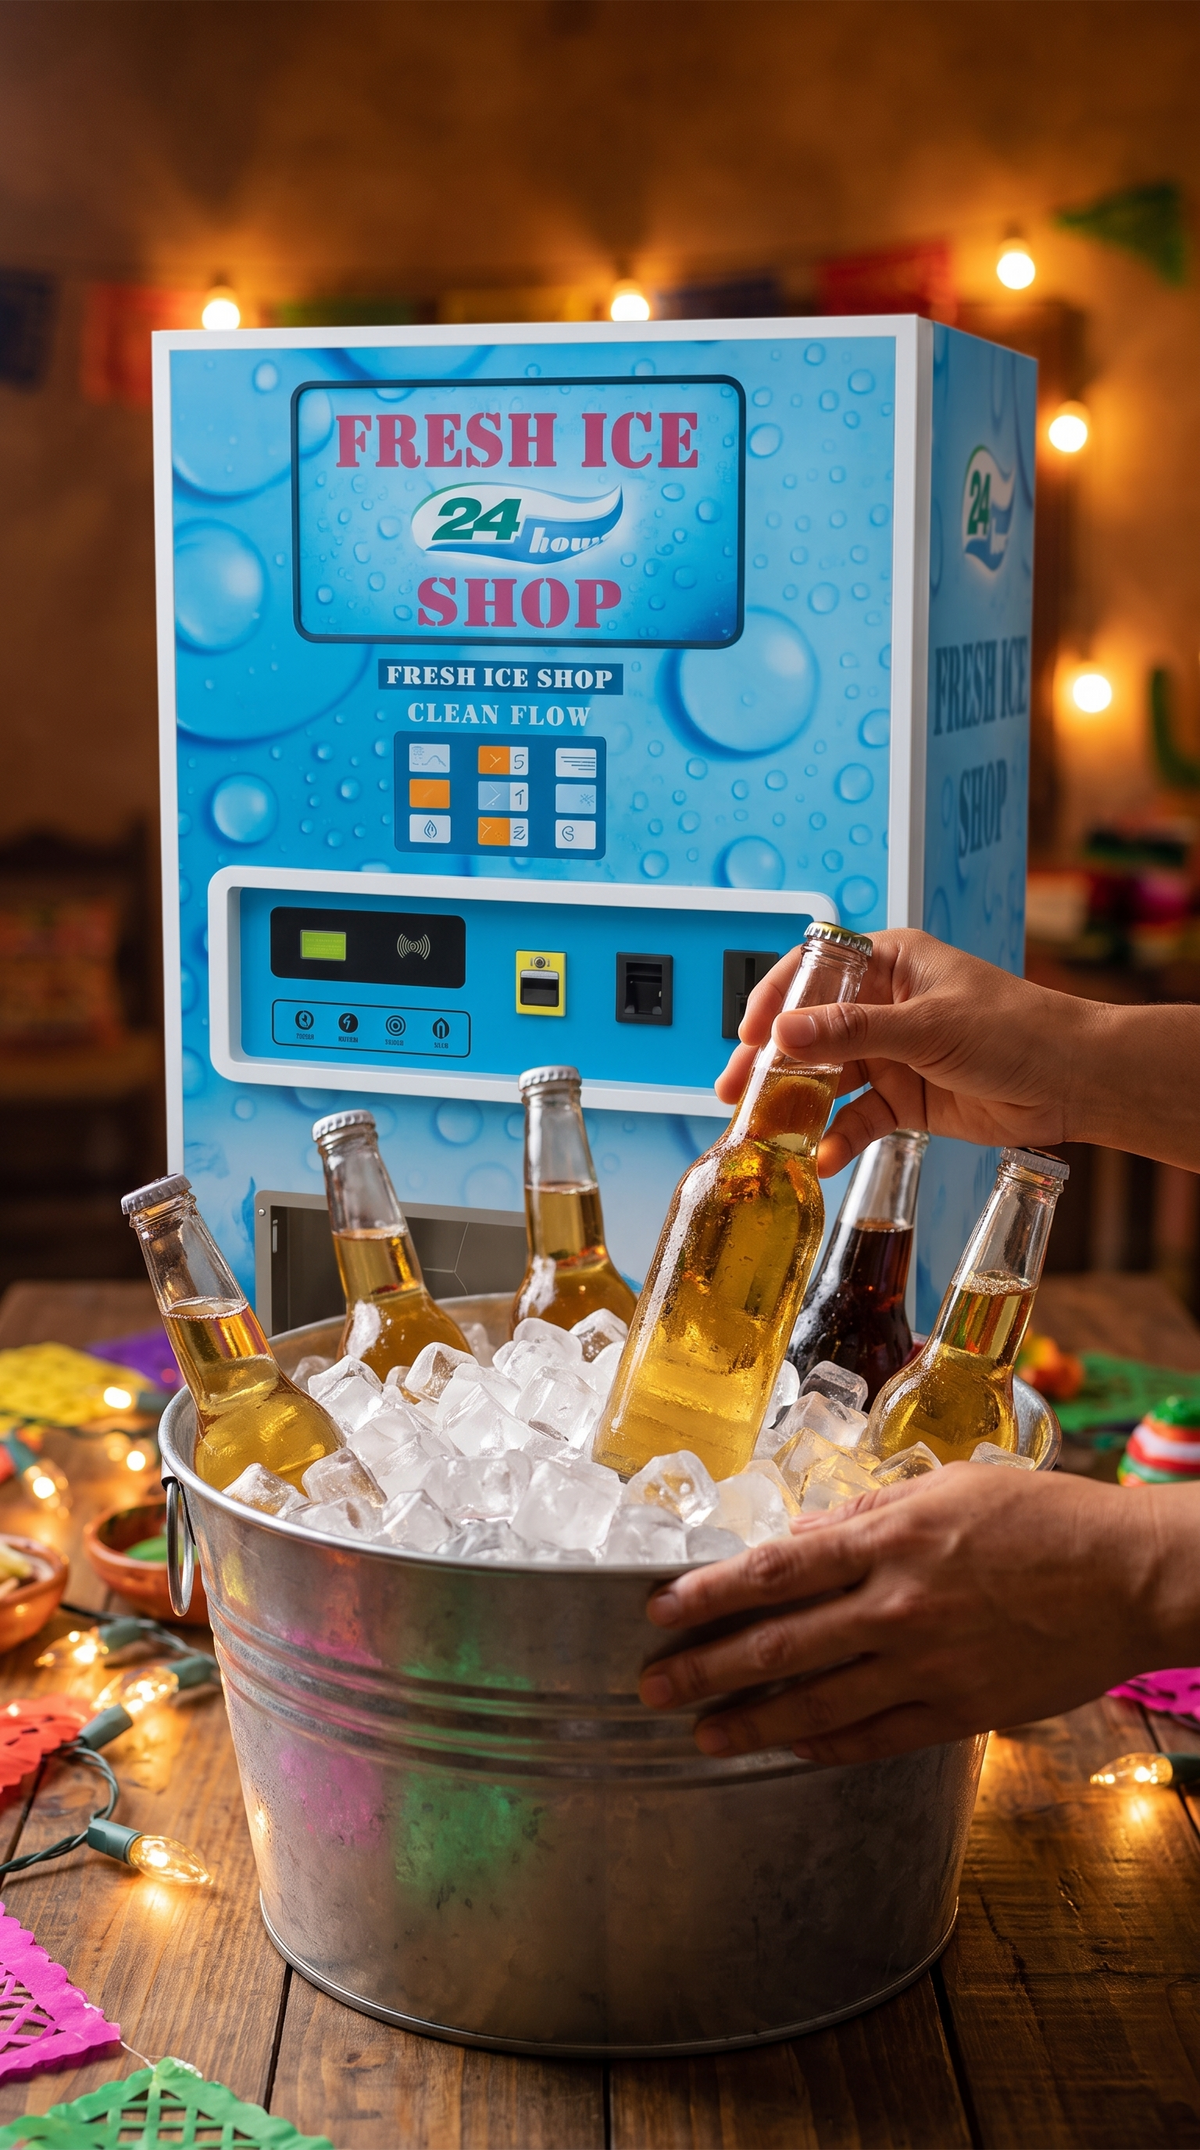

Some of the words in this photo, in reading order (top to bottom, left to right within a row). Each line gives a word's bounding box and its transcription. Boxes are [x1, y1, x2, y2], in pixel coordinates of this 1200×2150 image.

[336, 413, 557, 469] FRESH
[582, 412, 698, 469] ICE
[431, 497, 522, 540] 24
[967, 469, 991, 535] 24
[417, 577, 622, 629] SHOP
[386, 665, 476, 687] FRESH
[483, 667, 529, 687] ICE
[537, 669, 613, 689] SHOP
[933, 639, 996, 736] FRESH
[1000, 635, 1028, 719] ICE
[407, 703, 499, 725] CLEAN
[511, 705, 591, 727] FLOW
[958, 758, 1007, 857] SHOP
